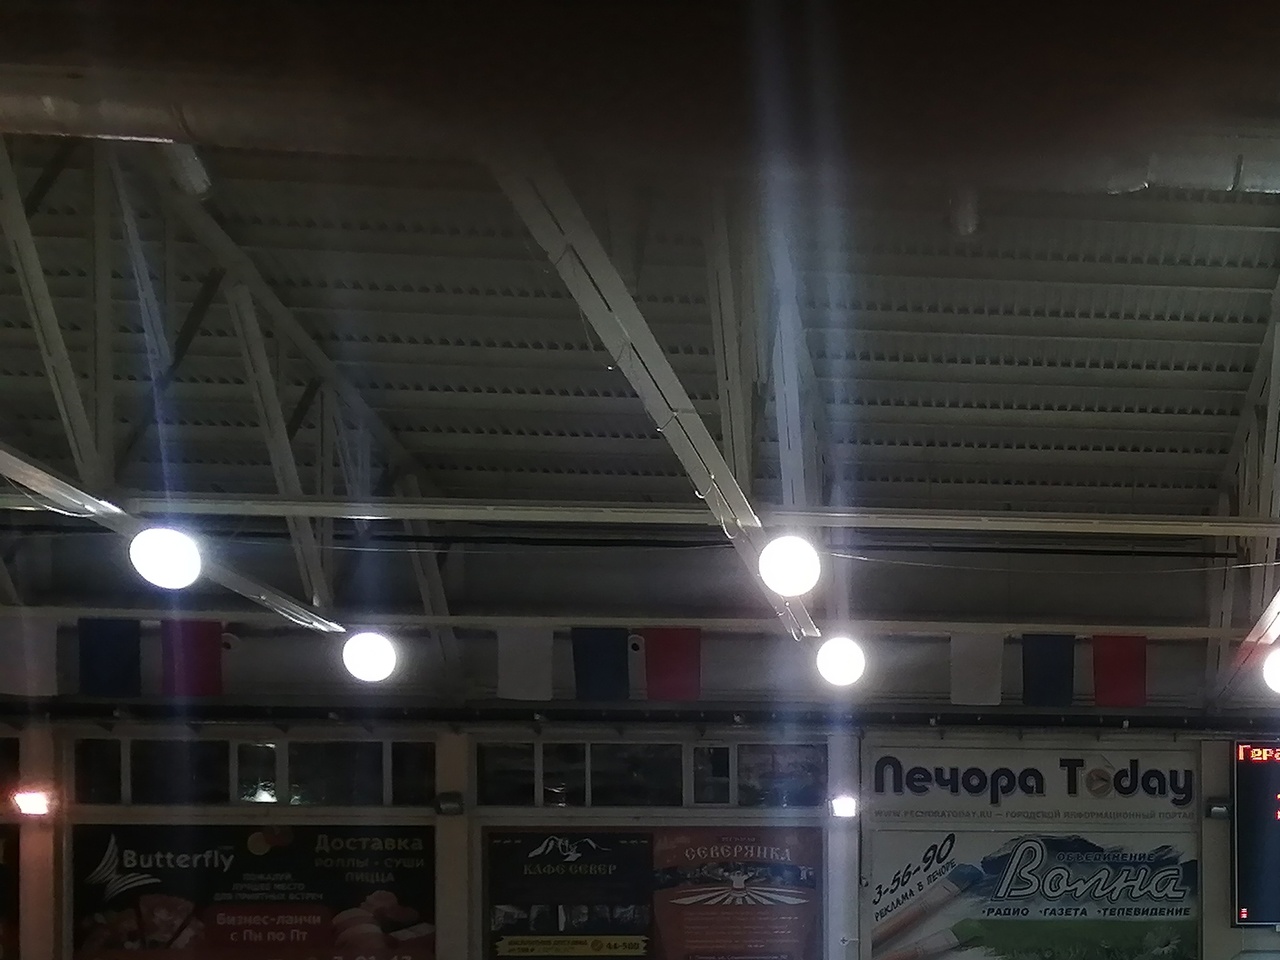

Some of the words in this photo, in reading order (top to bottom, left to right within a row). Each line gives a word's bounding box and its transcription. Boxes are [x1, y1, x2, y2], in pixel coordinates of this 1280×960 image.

[874, 755, 1044, 804] Печора
[315, 834, 424, 854] Доставка
[123, 849, 234, 873] Butterfly
[384, 857, 424, 869] СУШИ
[872, 833, 956, 905] 3-56-90
[985, 906, 1029, 918] РАДИО
[1043, 906, 1088, 918] ГАЗЕТА
[1101, 906, 1191, 918] ТЕЛЕВИДЕНИЕ
